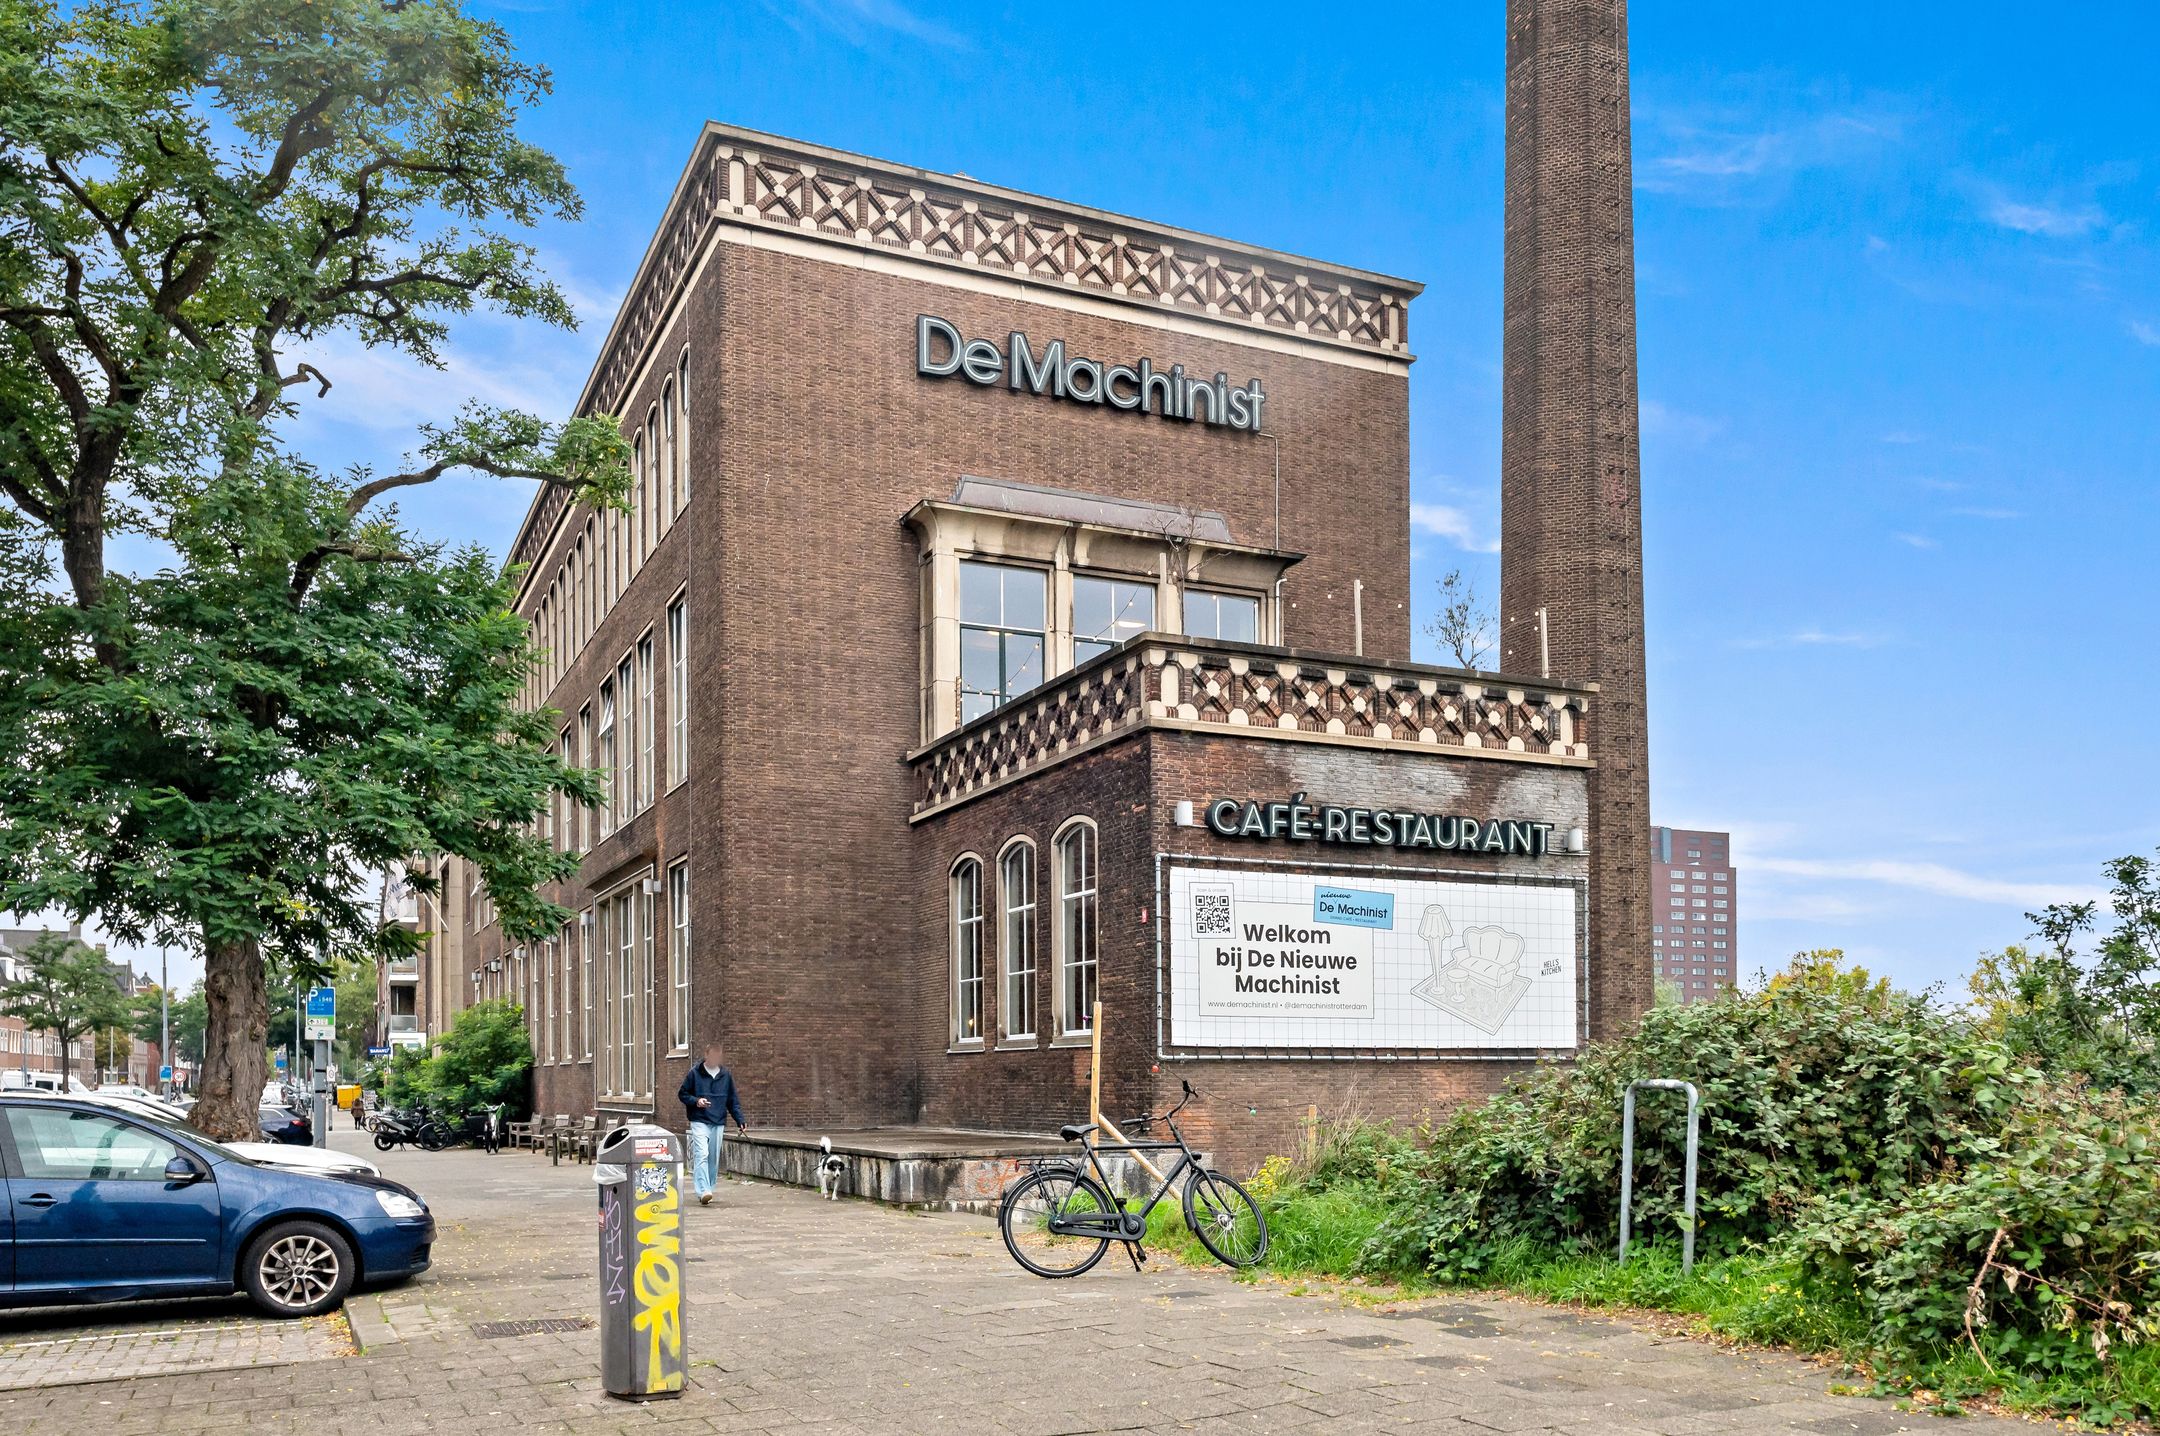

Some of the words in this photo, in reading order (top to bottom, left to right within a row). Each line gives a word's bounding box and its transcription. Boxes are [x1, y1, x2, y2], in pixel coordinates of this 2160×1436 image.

[917, 314, 1003, 385] De
[1008, 331, 1266, 433] Machinist
[1206, 792, 1555, 856] CAFÉ-RESTAURANT
[1320, 891, 1352, 899] nieuwe
[1319, 901, 1335, 913] De
[1337, 903, 1388, 919] Machinist
[1243, 923, 1331, 945] Welkom
[1216, 946, 1242, 973] bij
[1248, 949, 1275, 968] De
[1280, 949, 1358, 970] Nieuwe
[1540, 965, 1562, 976] KITCHEN
[1235, 974, 1340, 994] Machinist
[1207, 1001, 1279, 1009] www.demachinist.nl
[1284, 1002, 1368, 1010] @demachinistrotterdam
